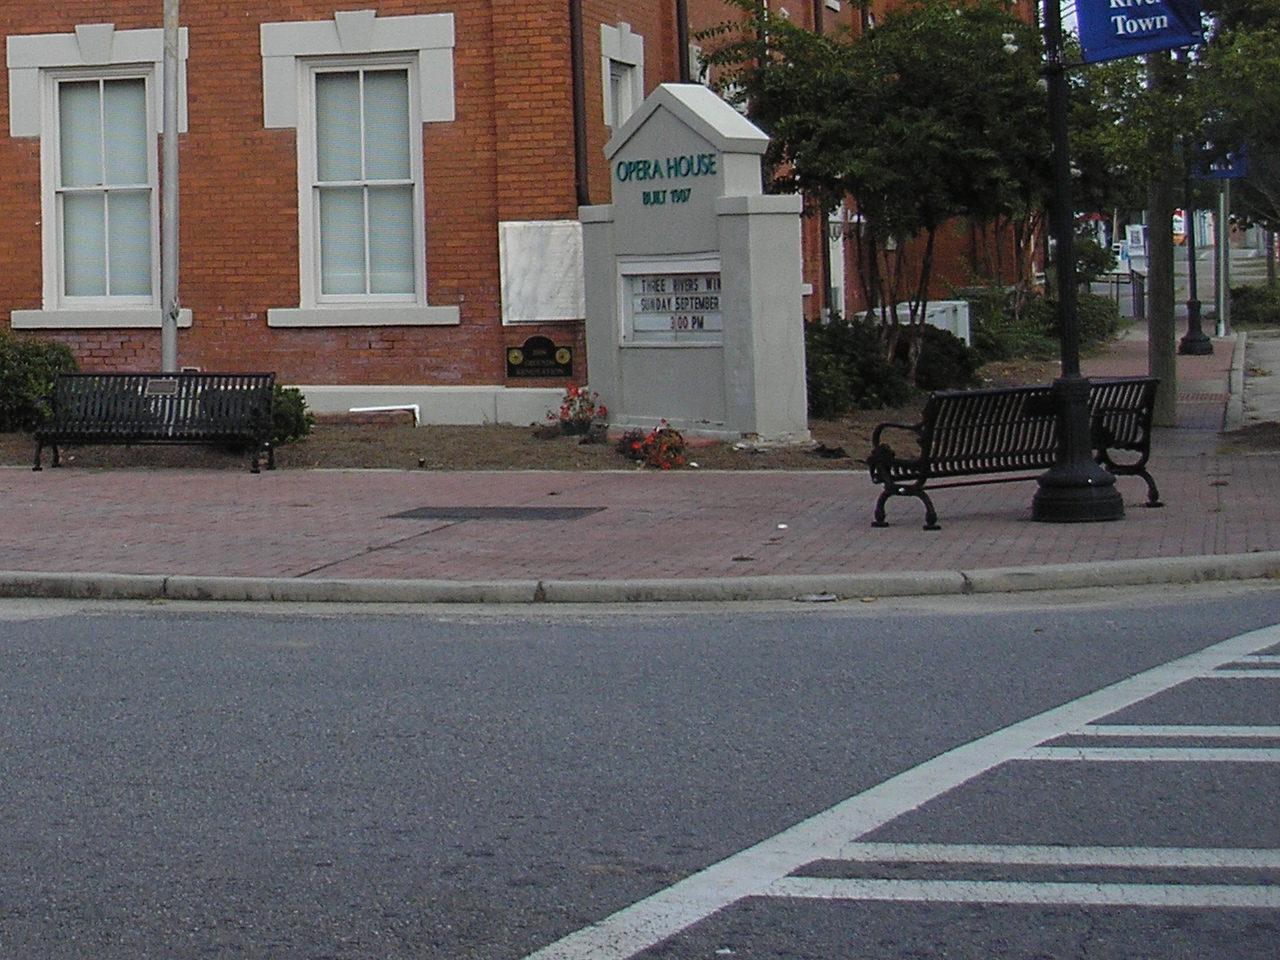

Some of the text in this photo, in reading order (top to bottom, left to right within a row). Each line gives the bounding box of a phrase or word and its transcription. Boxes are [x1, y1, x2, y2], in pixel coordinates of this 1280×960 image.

[1111, 15, 1168, 35] Town
[616, 153, 717, 182] OPERA HOUSE
[642, 189, 667, 206] BUILT
[641, 279, 666, 293] THREE
[672, 278, 699, 292] RIVERS
[640, 296, 719, 311] SUNDAY SEPTEMBER
[691, 315, 704, 329] PM
